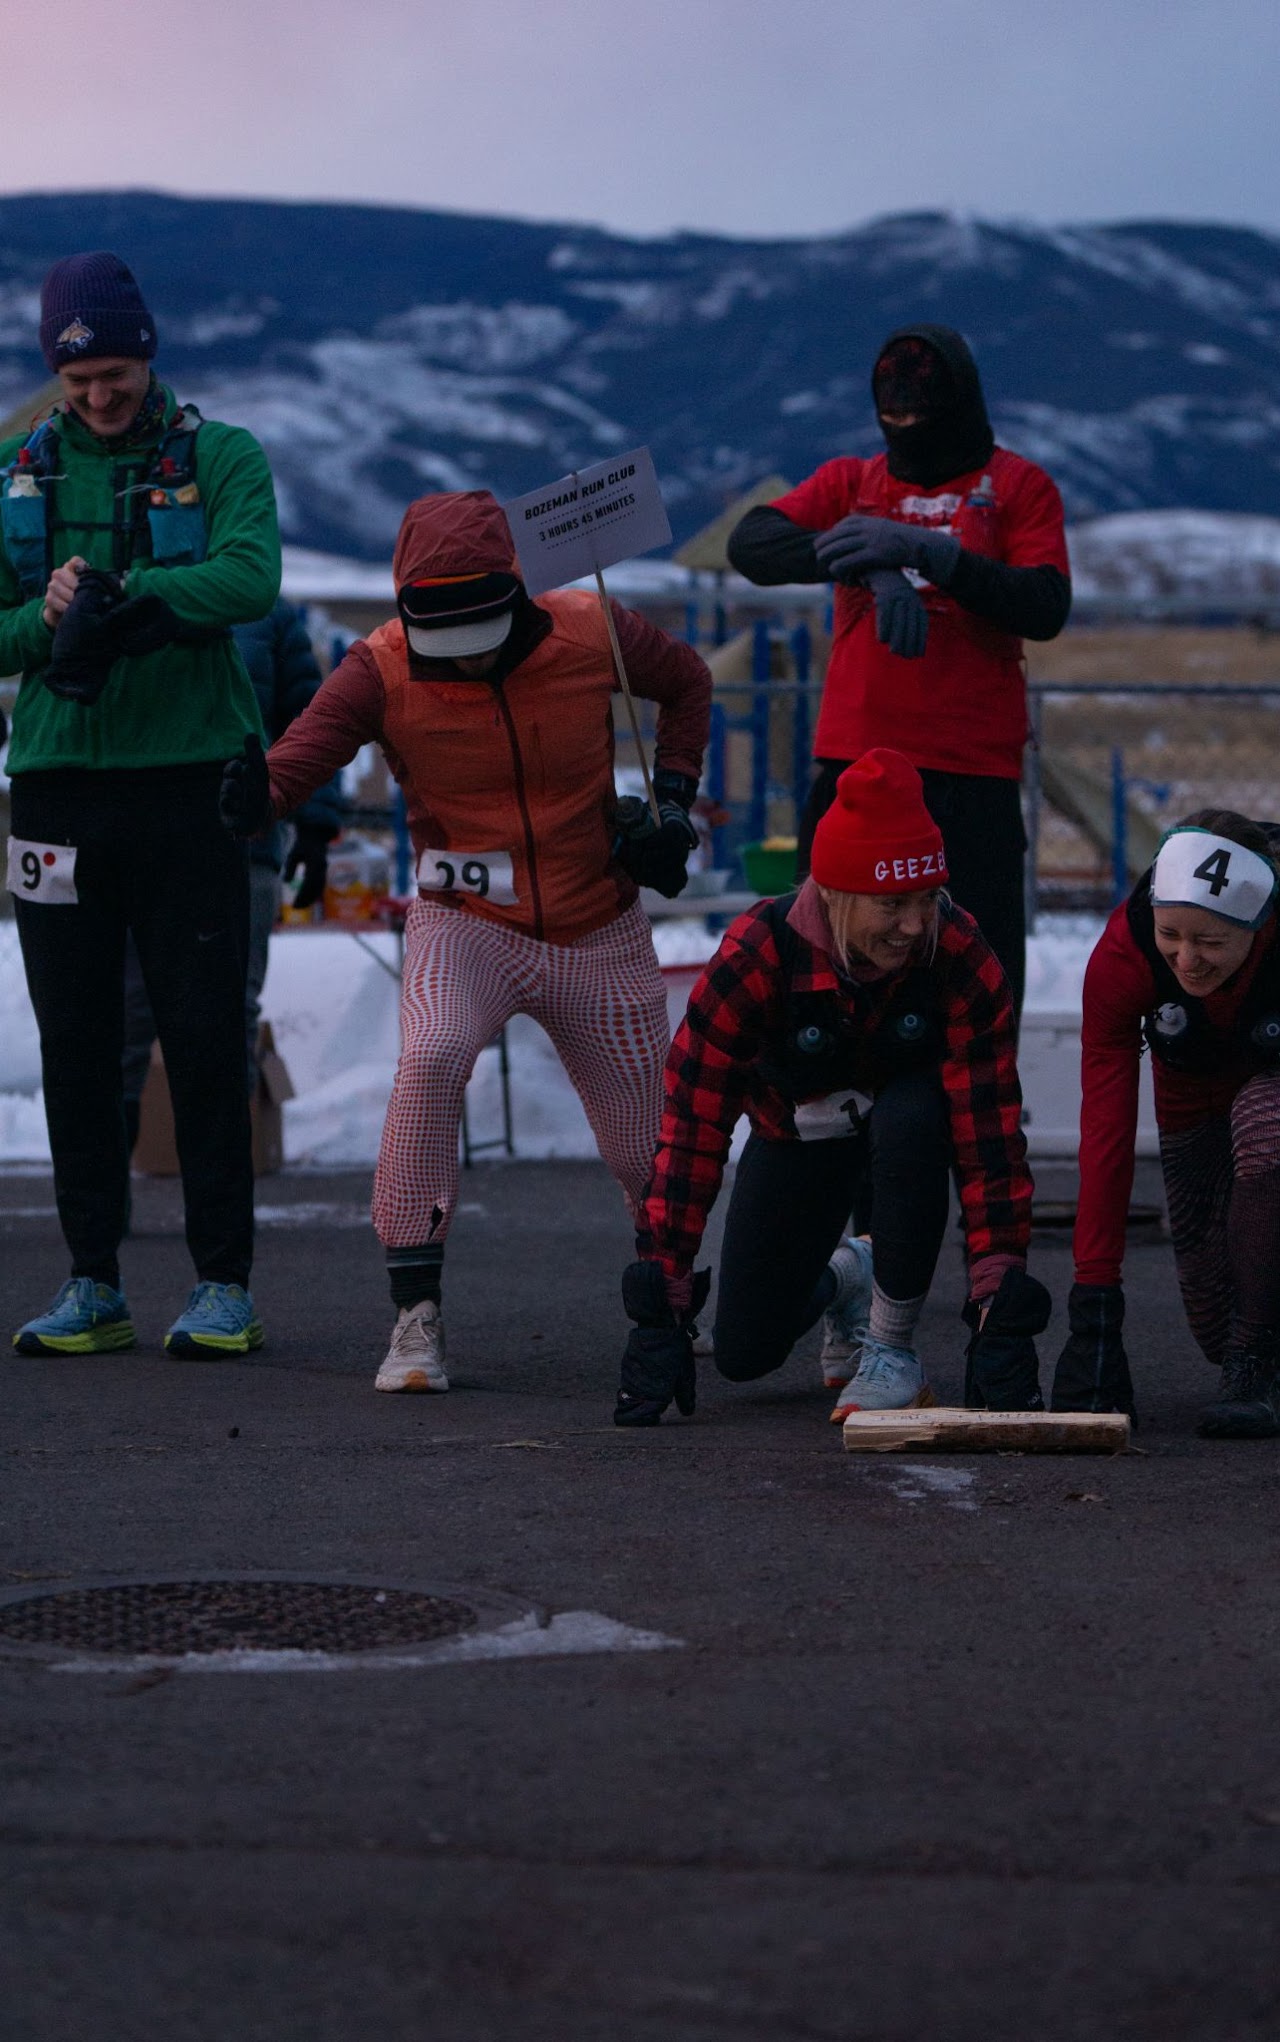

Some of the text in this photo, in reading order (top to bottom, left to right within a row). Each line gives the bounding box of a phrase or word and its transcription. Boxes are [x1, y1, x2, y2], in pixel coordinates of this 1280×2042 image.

[525, 465, 636, 520] BOZEMAN RUN CLUB
[538, 493, 636, 542] 3 HOURS 45 MINUTES
[21, 851, 41, 890] 9
[1193, 848, 1231, 897] 4
